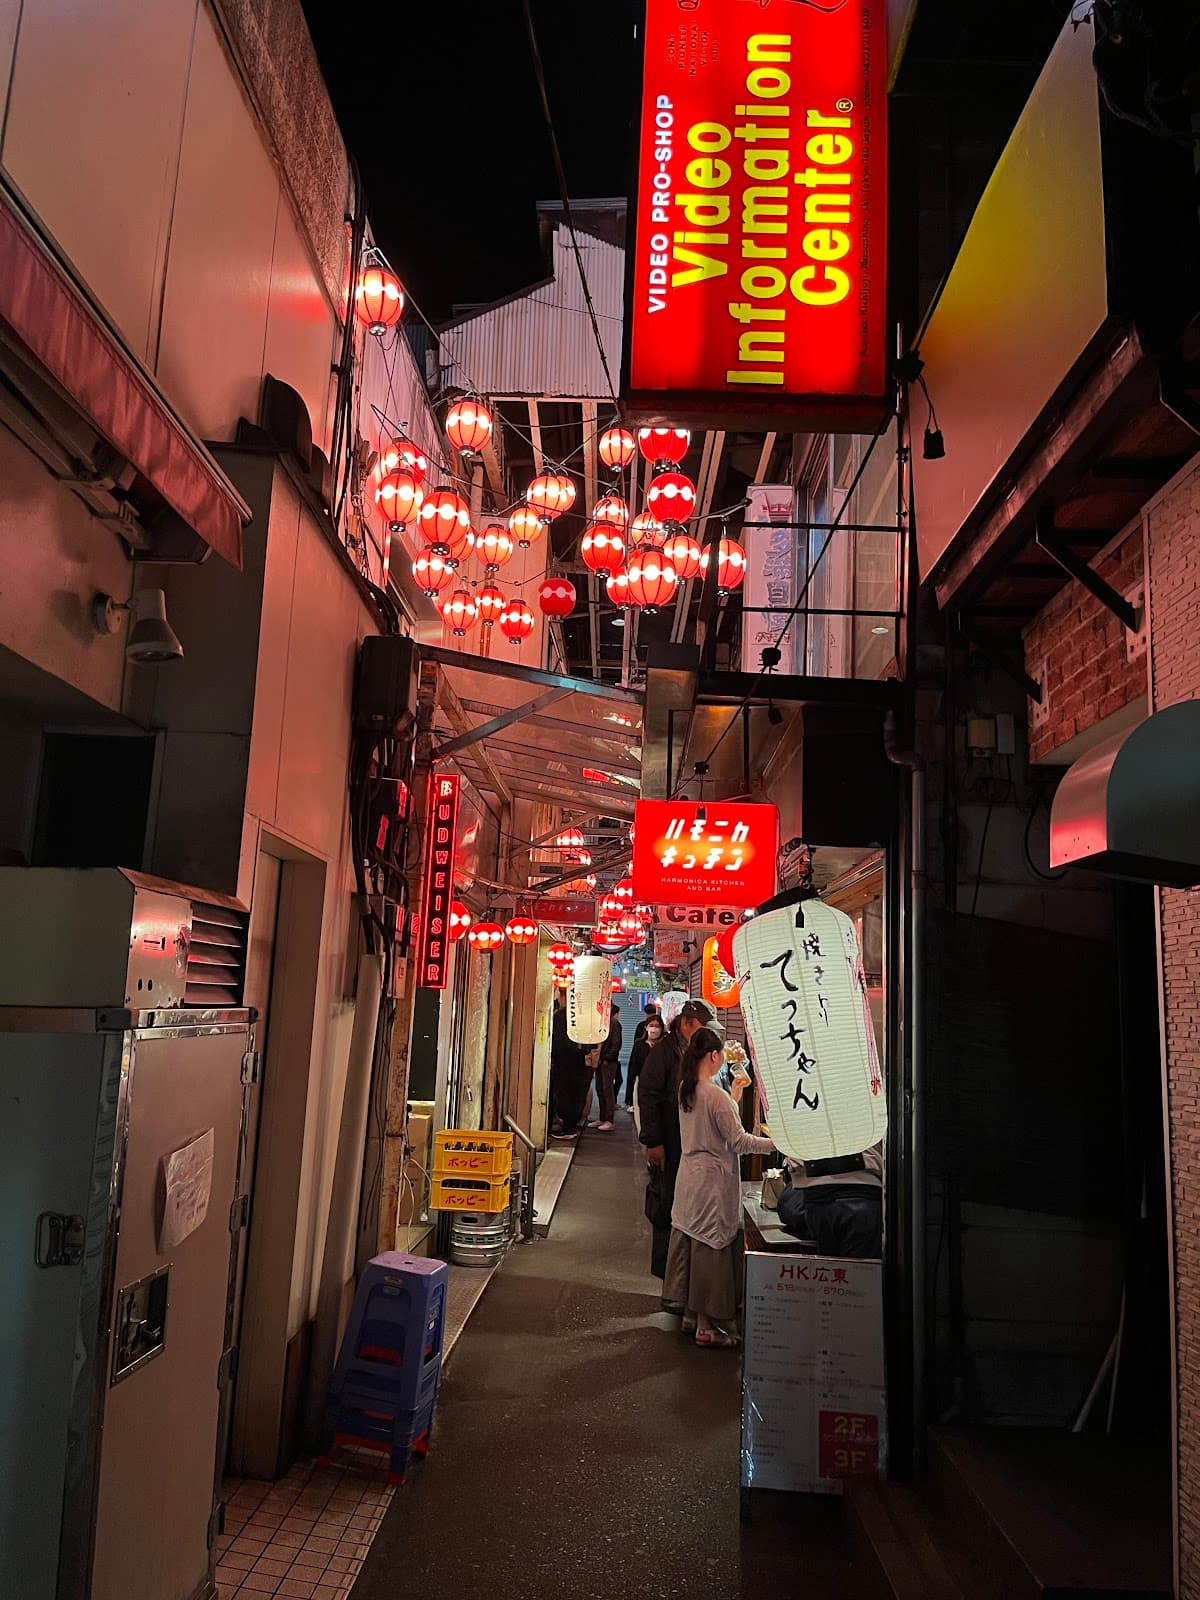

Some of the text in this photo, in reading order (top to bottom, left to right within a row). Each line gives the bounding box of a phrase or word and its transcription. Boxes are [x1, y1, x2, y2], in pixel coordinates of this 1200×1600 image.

[647, 94, 675, 314] VIDEO PRO-SHOP
[671, 121, 732, 288] Video
[726, 33, 792, 385] Information
[665, 818, 750, 843] ハモニカ
[660, 846, 744, 871] キッチン
[426, 779, 454, 981] BUDWEISER
[661, 877, 745, 887] HARMONICA KITCHEN
[666, 906, 735, 926] Cafe
[760, 949, 820, 1111] てっちゃん
[447, 1157, 489, 1169] ホッピー
[445, 1194, 487, 1206] ホッピー
[833, 1416, 867, 1435] 2F
[833, 1448, 867, 1468] 3F
